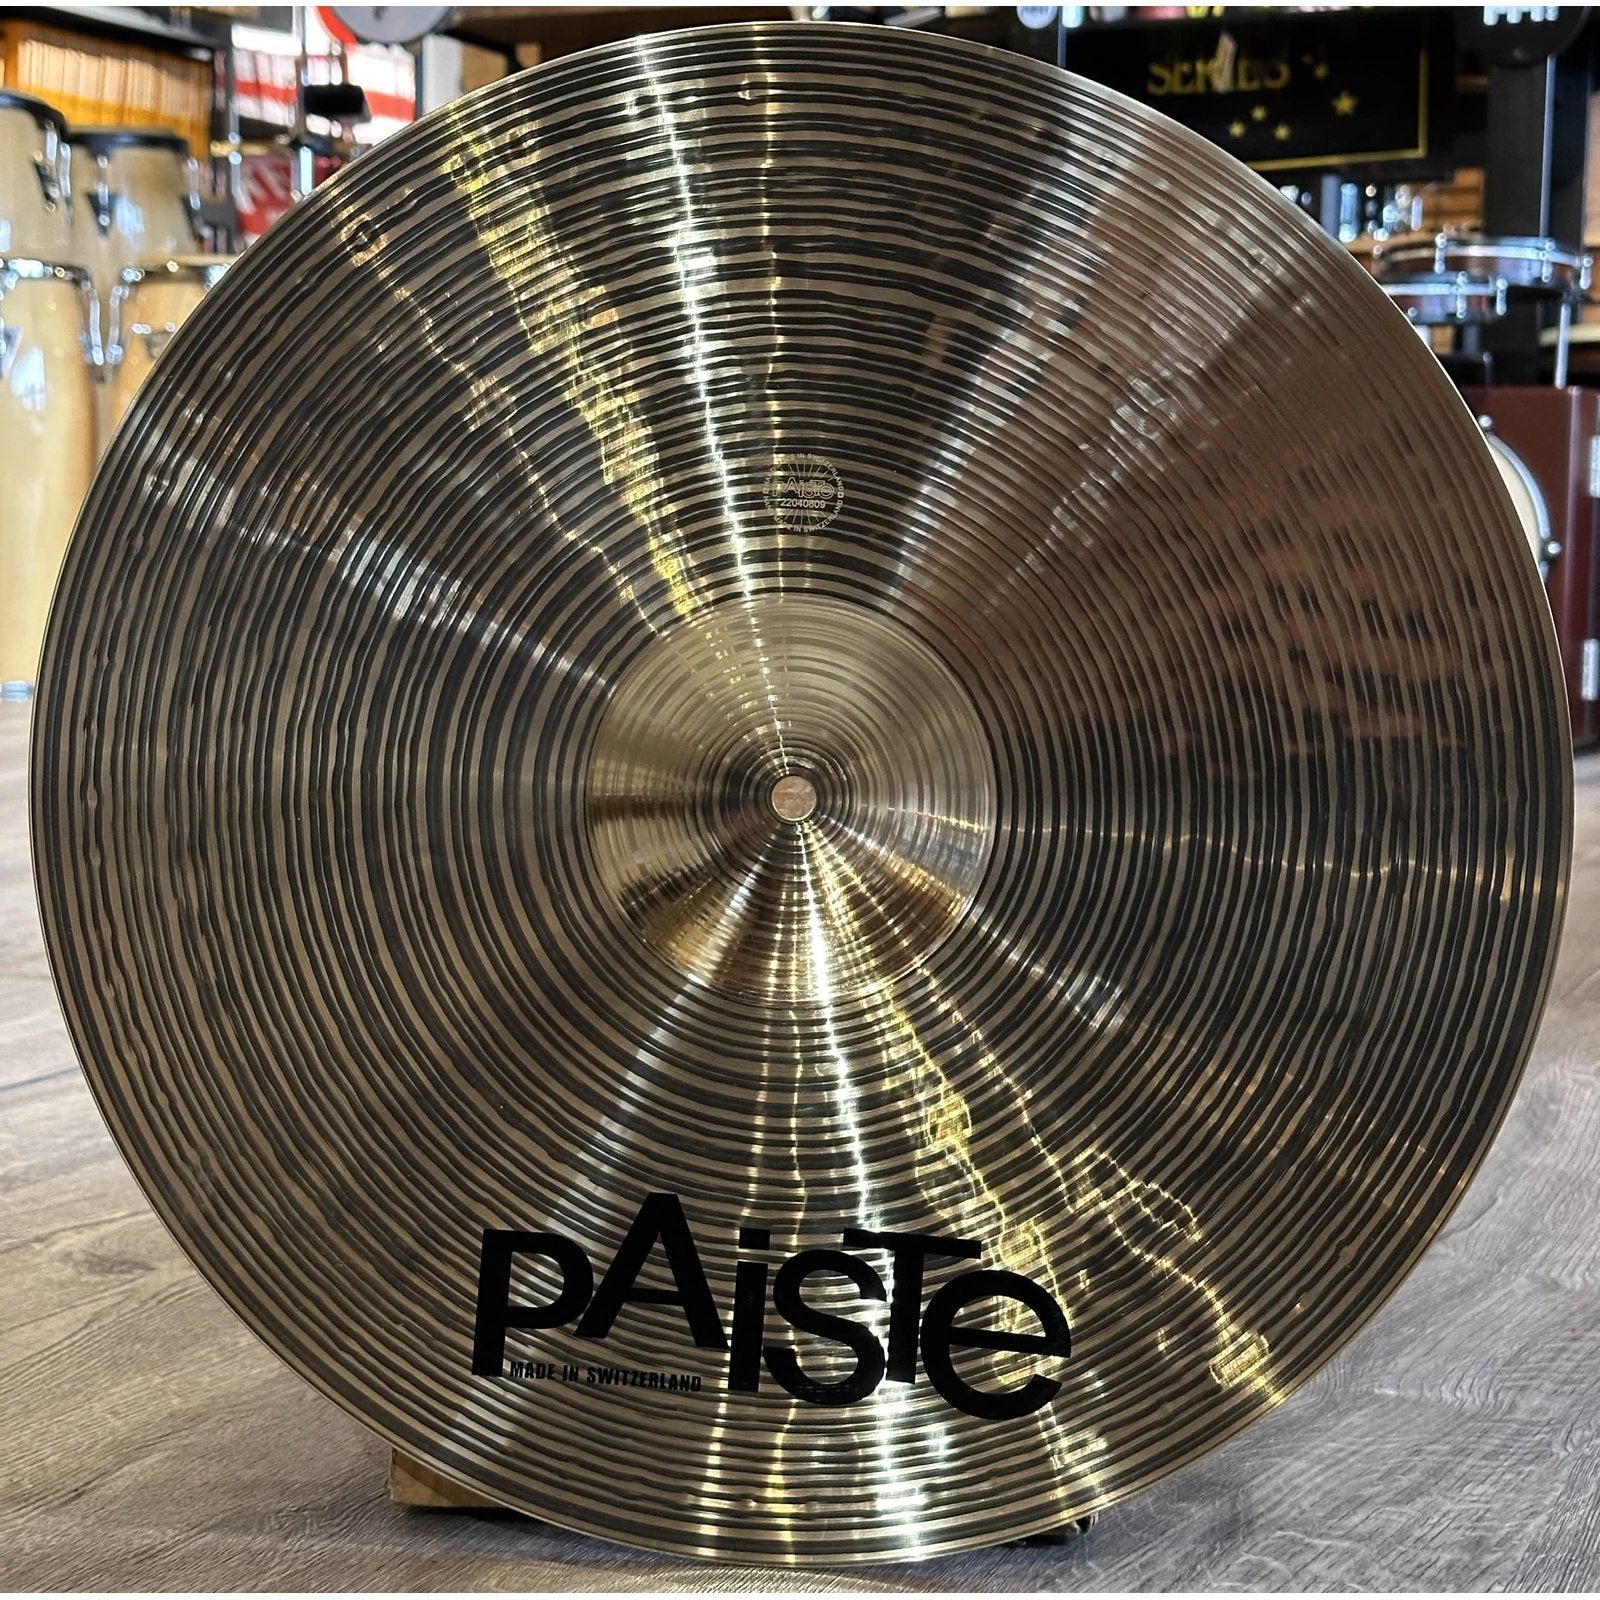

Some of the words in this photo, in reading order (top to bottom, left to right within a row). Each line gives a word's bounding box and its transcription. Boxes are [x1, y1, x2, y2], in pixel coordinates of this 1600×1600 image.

[510, 1361, 555, 1380] MADE
[563, 1365, 578, 1382] IN
[586, 1367, 702, 1392] SWITZERLAND
